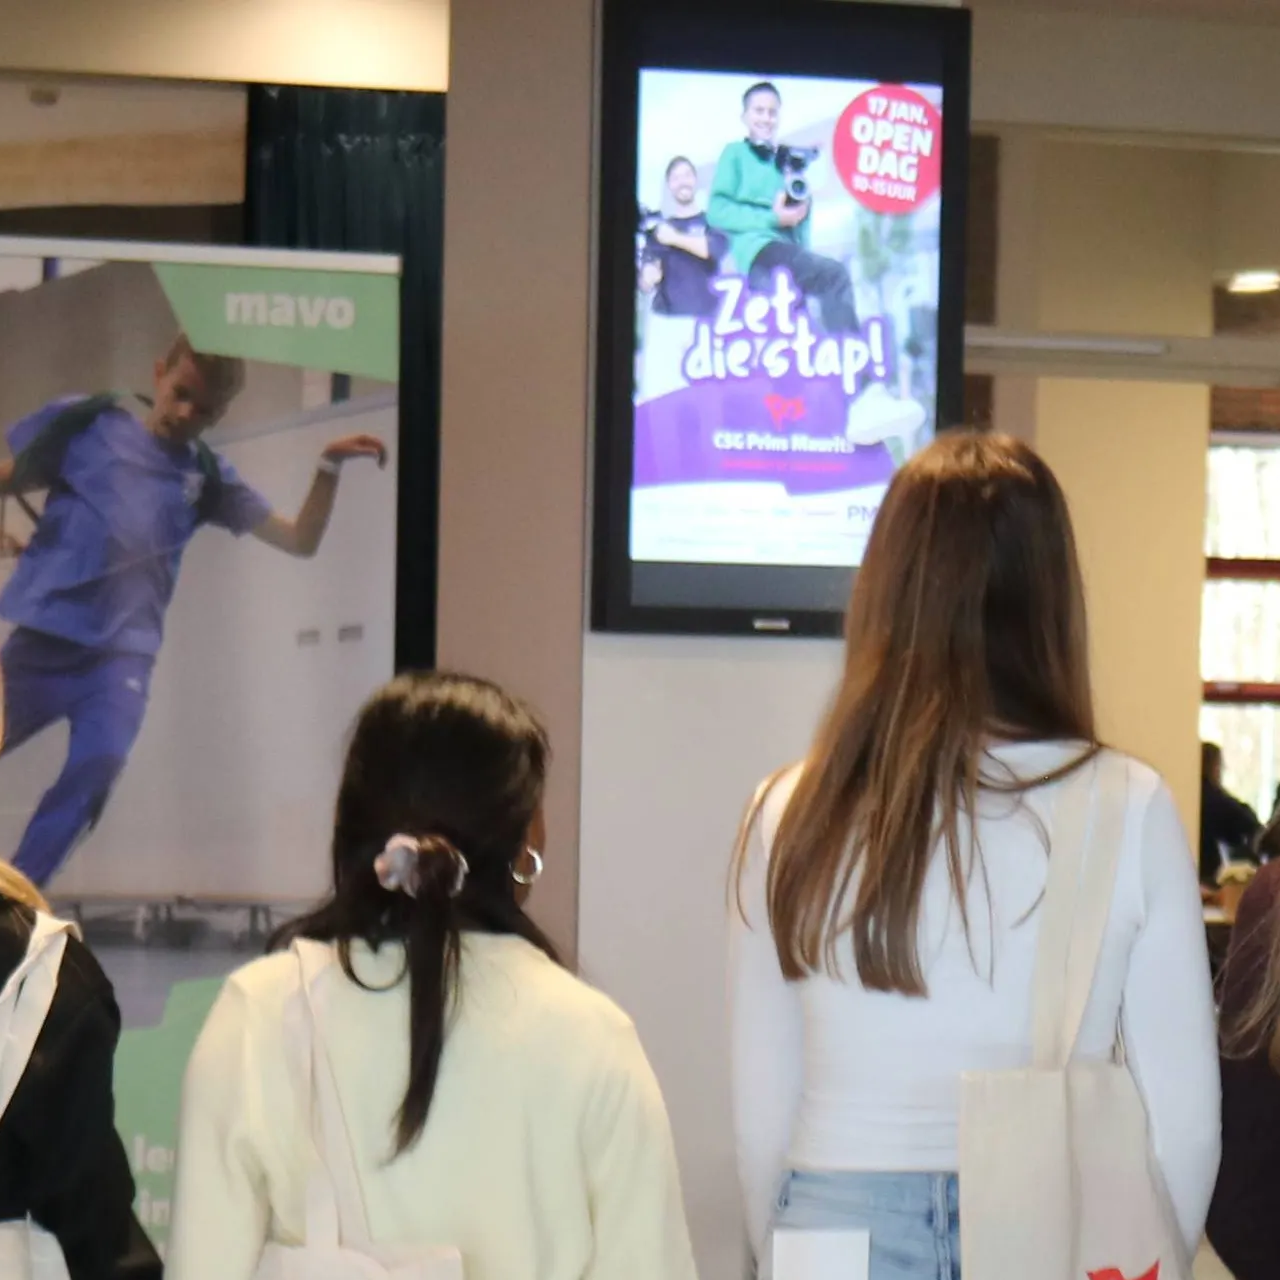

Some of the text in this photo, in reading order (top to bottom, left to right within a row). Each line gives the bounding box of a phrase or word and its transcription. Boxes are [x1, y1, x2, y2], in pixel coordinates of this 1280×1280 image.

[851, 115, 933, 157] OPEN
[858, 145, 918, 183] DAG
[225, 292, 355, 329] mavo
[713, 272, 796, 335] Zet
[685, 316, 886, 395] die stap!
